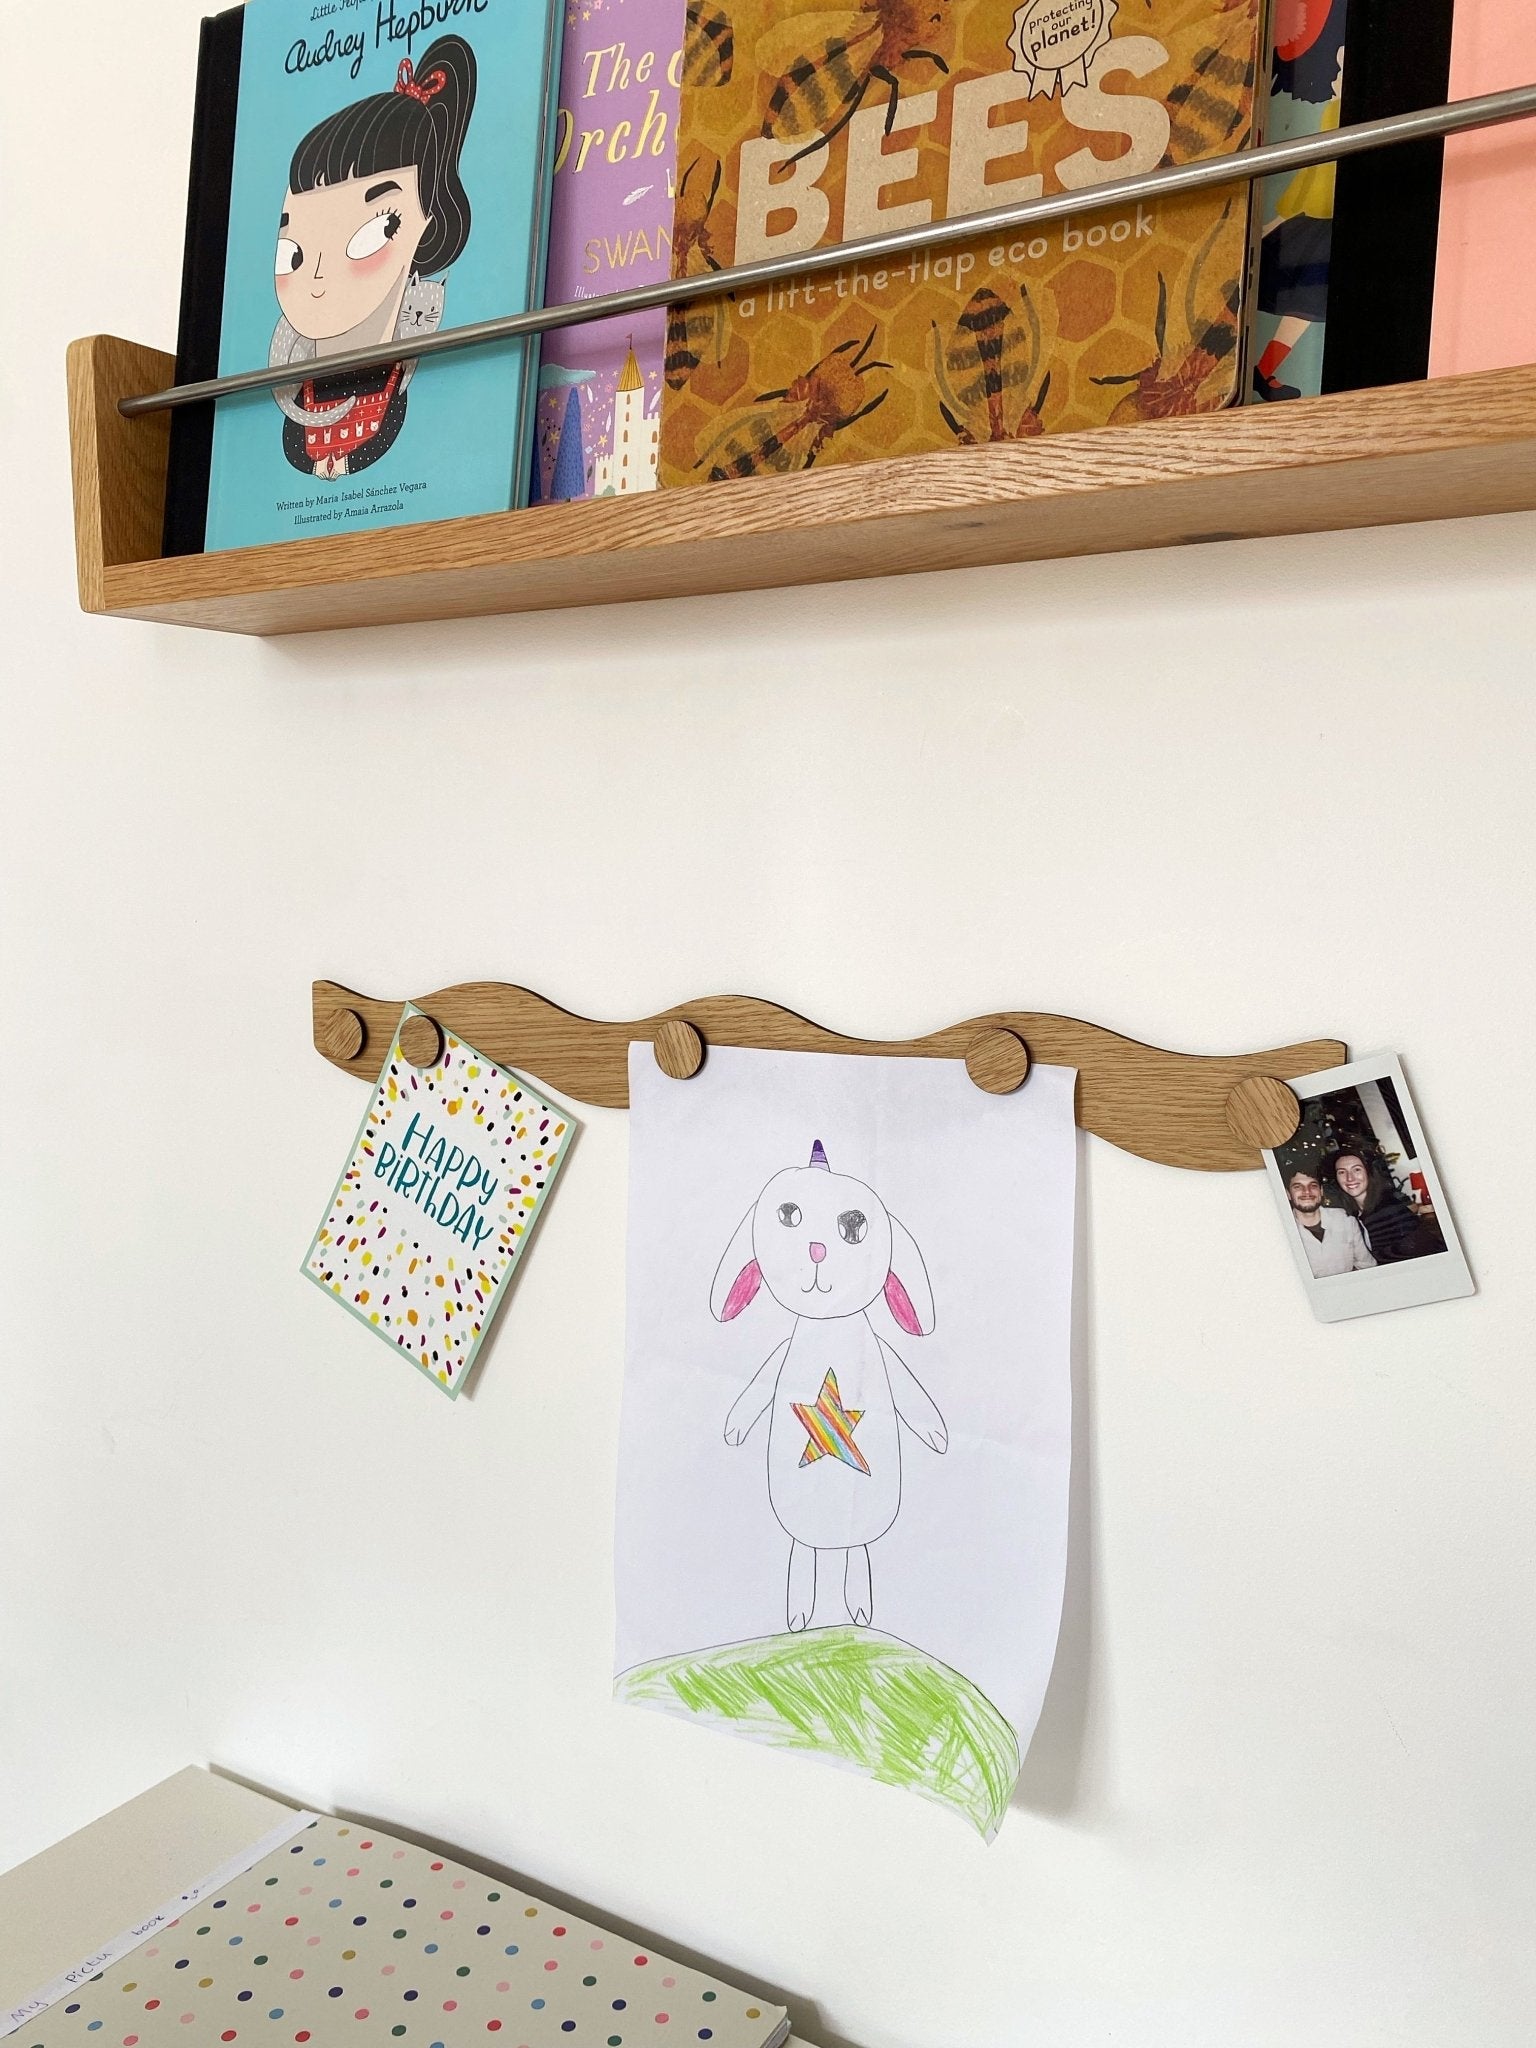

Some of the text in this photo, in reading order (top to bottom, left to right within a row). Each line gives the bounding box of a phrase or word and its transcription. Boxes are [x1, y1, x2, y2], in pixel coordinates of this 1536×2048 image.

[1029, 0, 1093, 34] protecting
[1030, 9, 1096, 61] planet!
[1051, 16, 1072, 31] our
[284, 29, 365, 79] Audrey
[582, 42, 655, 98] The
[734, 35, 1171, 268] BEES
[738, 297, 755, 318] a
[987, 238, 1048, 268] eco
[1062, 204, 1154, 254] book
[276, 500, 304, 511] Written
[305, 497, 315, 508] by
[341, 488, 364, 501] Isabel
[399, 482, 427, 494] Vegara
[294, 499, 404, 525] Illustrated by Amaia Arrazola
